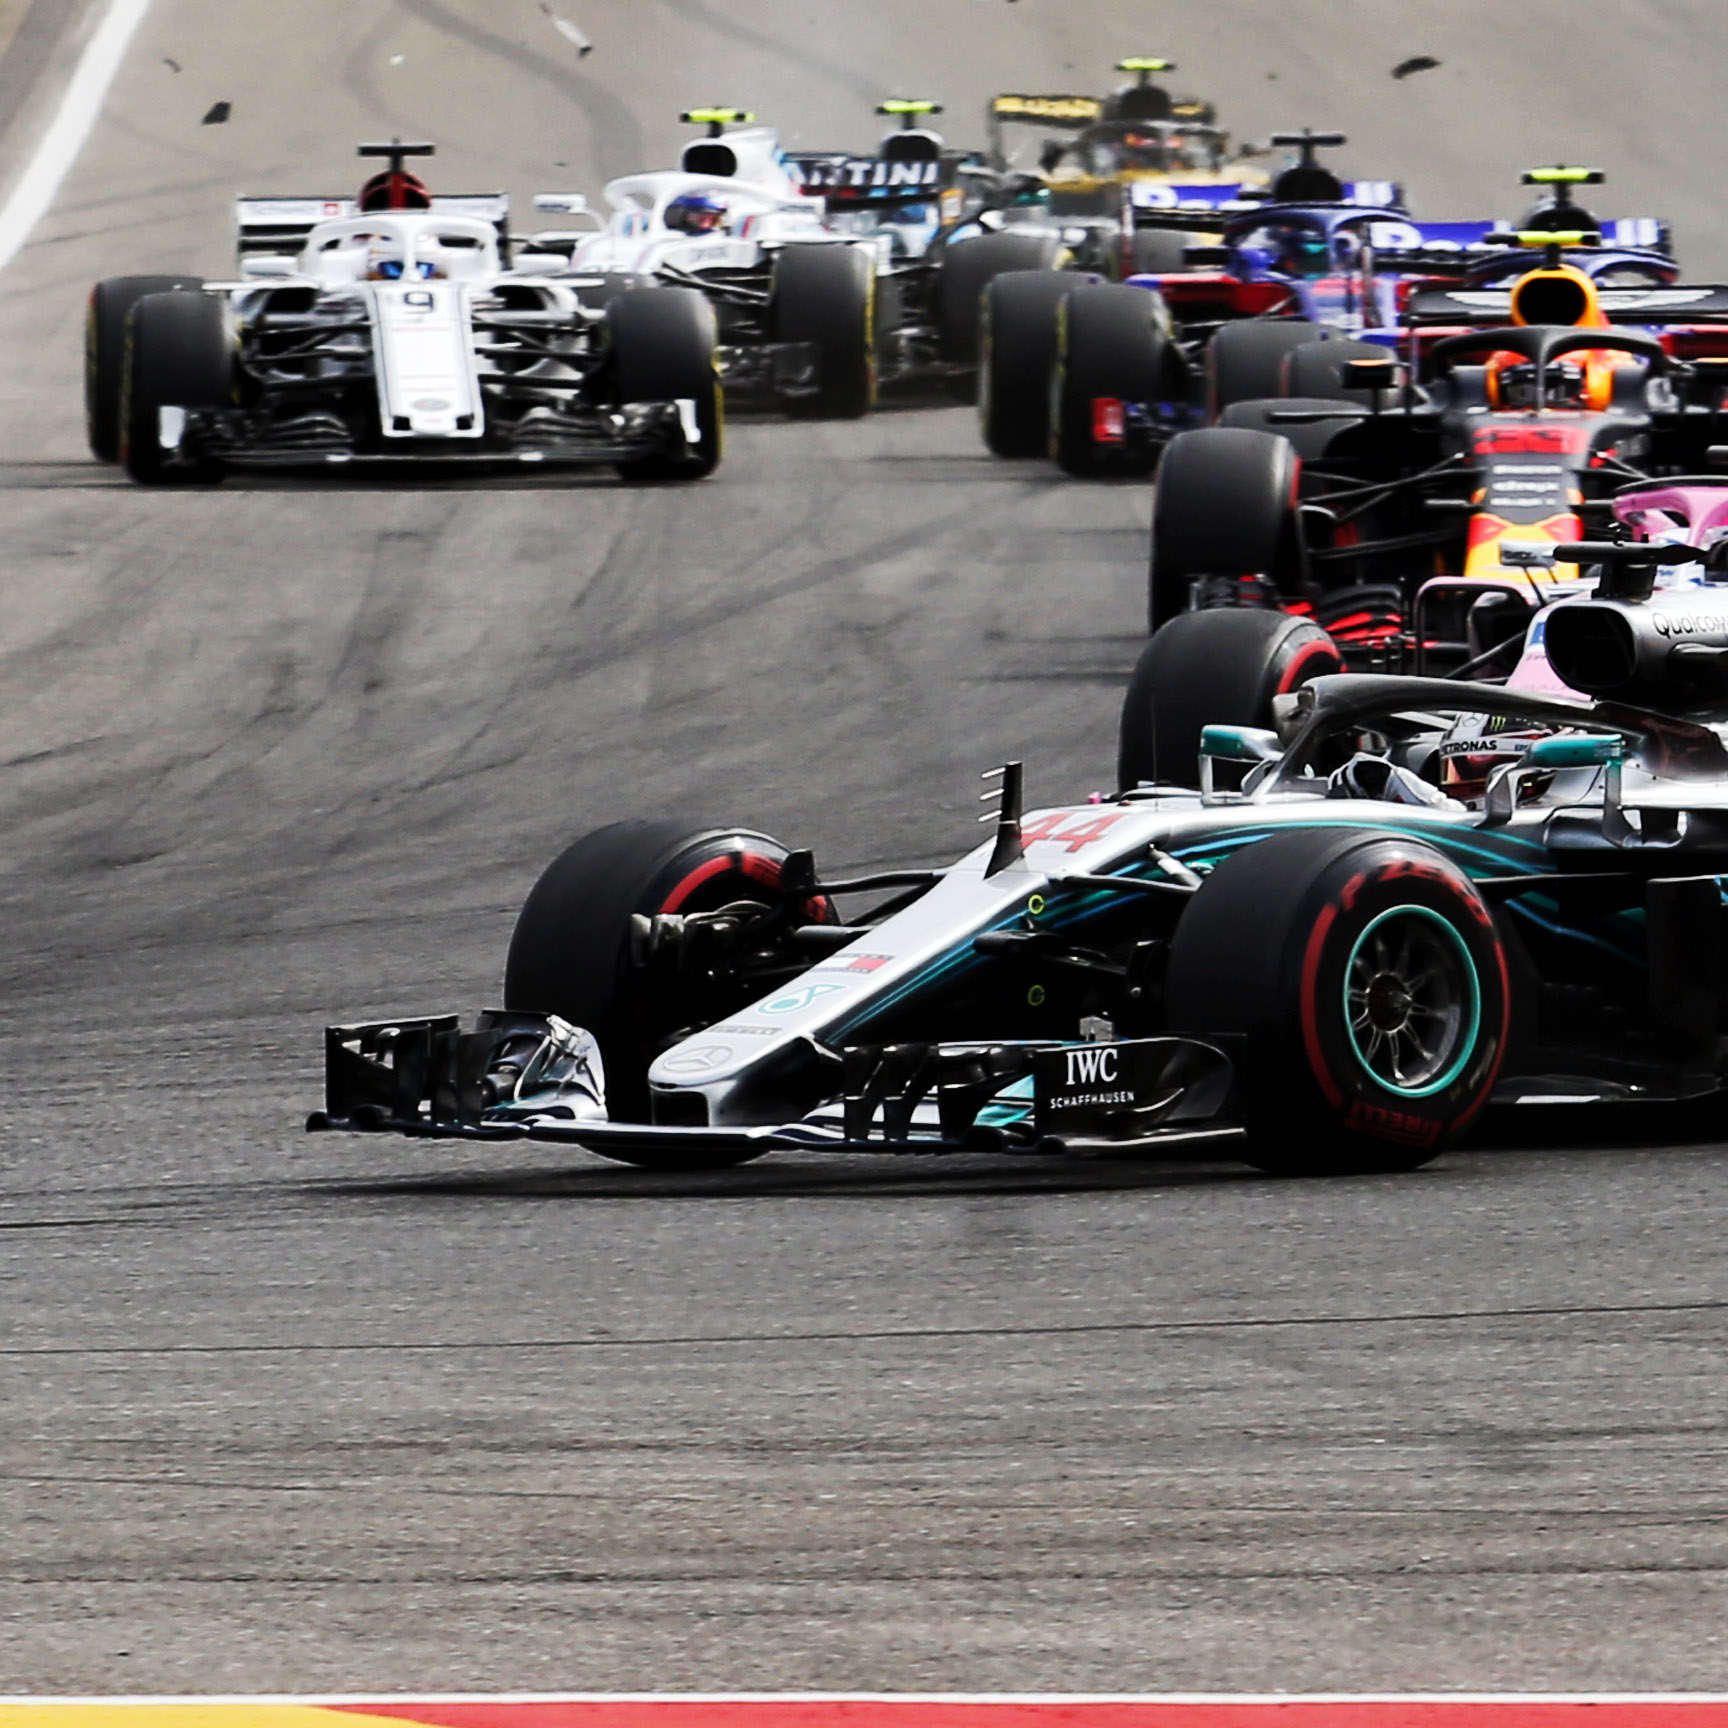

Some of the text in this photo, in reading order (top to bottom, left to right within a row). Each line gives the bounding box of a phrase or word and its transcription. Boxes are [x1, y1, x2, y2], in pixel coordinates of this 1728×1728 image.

[403, 290, 434, 314] 9
[1020, 811, 1128, 853] 44
[1066, 1048, 1119, 1087] IWC
[1050, 1089, 1135, 1111] SCHAFFHAUSEN
